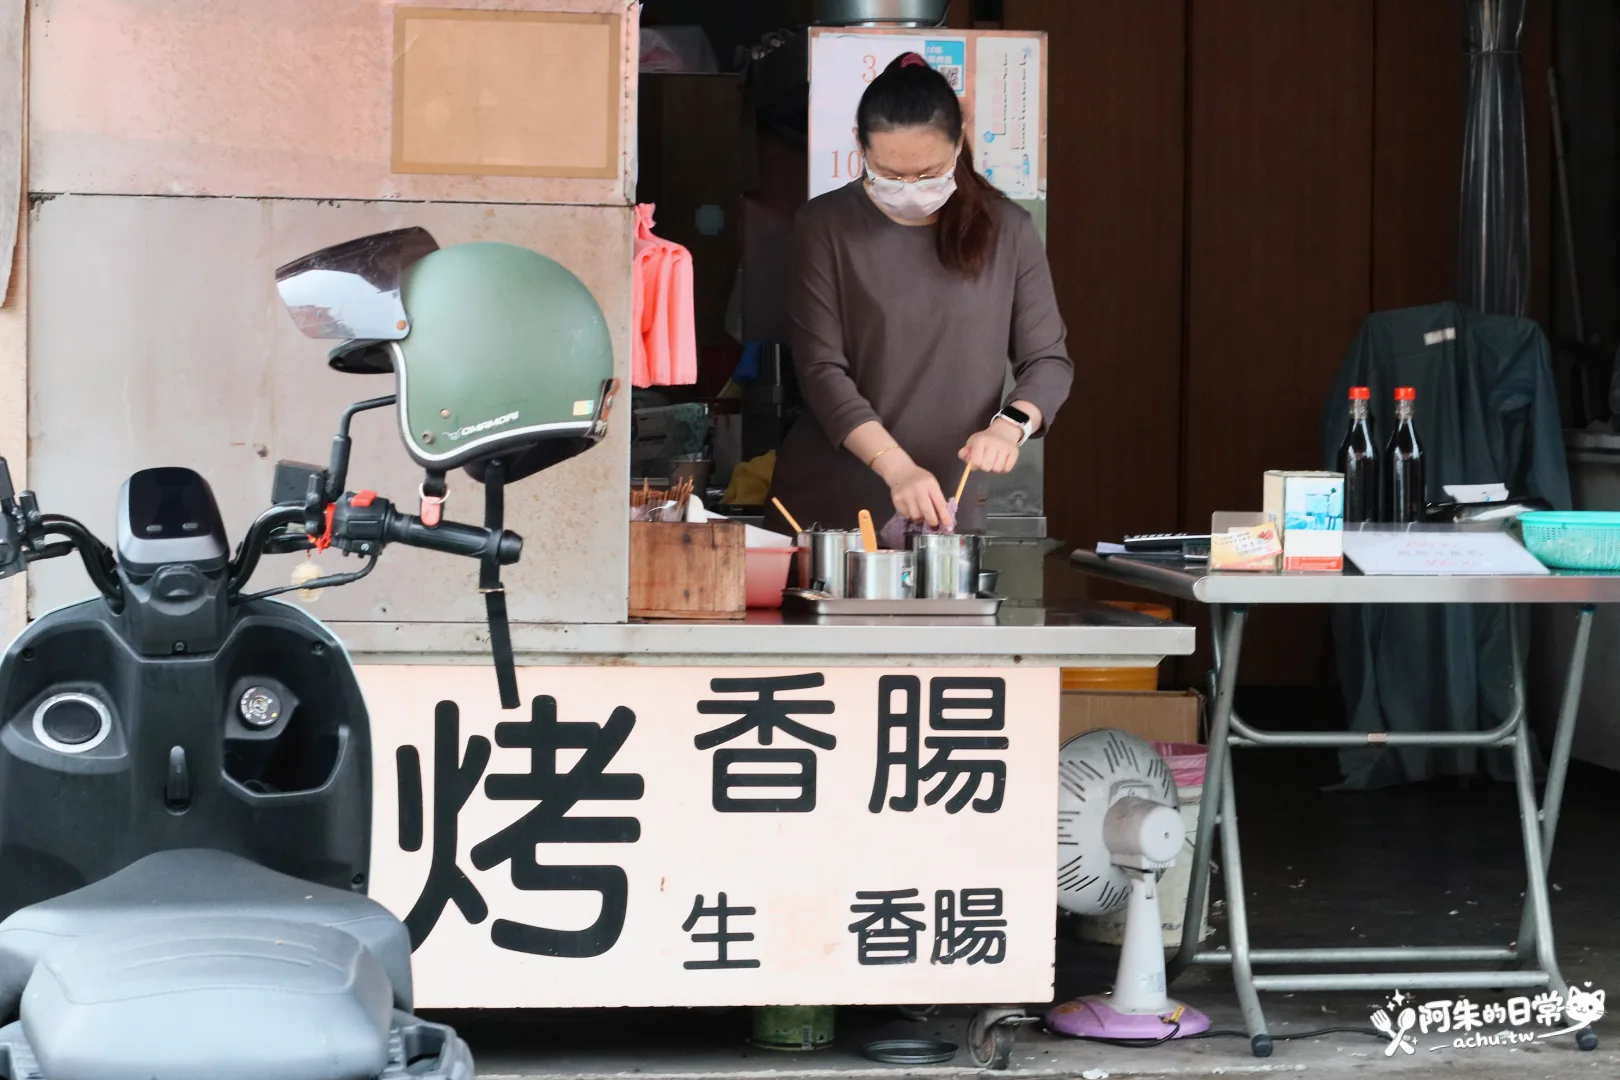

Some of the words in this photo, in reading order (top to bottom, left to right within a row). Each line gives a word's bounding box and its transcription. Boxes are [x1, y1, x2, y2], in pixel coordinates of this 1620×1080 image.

[694, 672, 1009, 814] 香腸
[396, 695, 645, 958] 烤
[681, 892, 761, 970] 生
[848, 888, 1008, 966] 香腸
